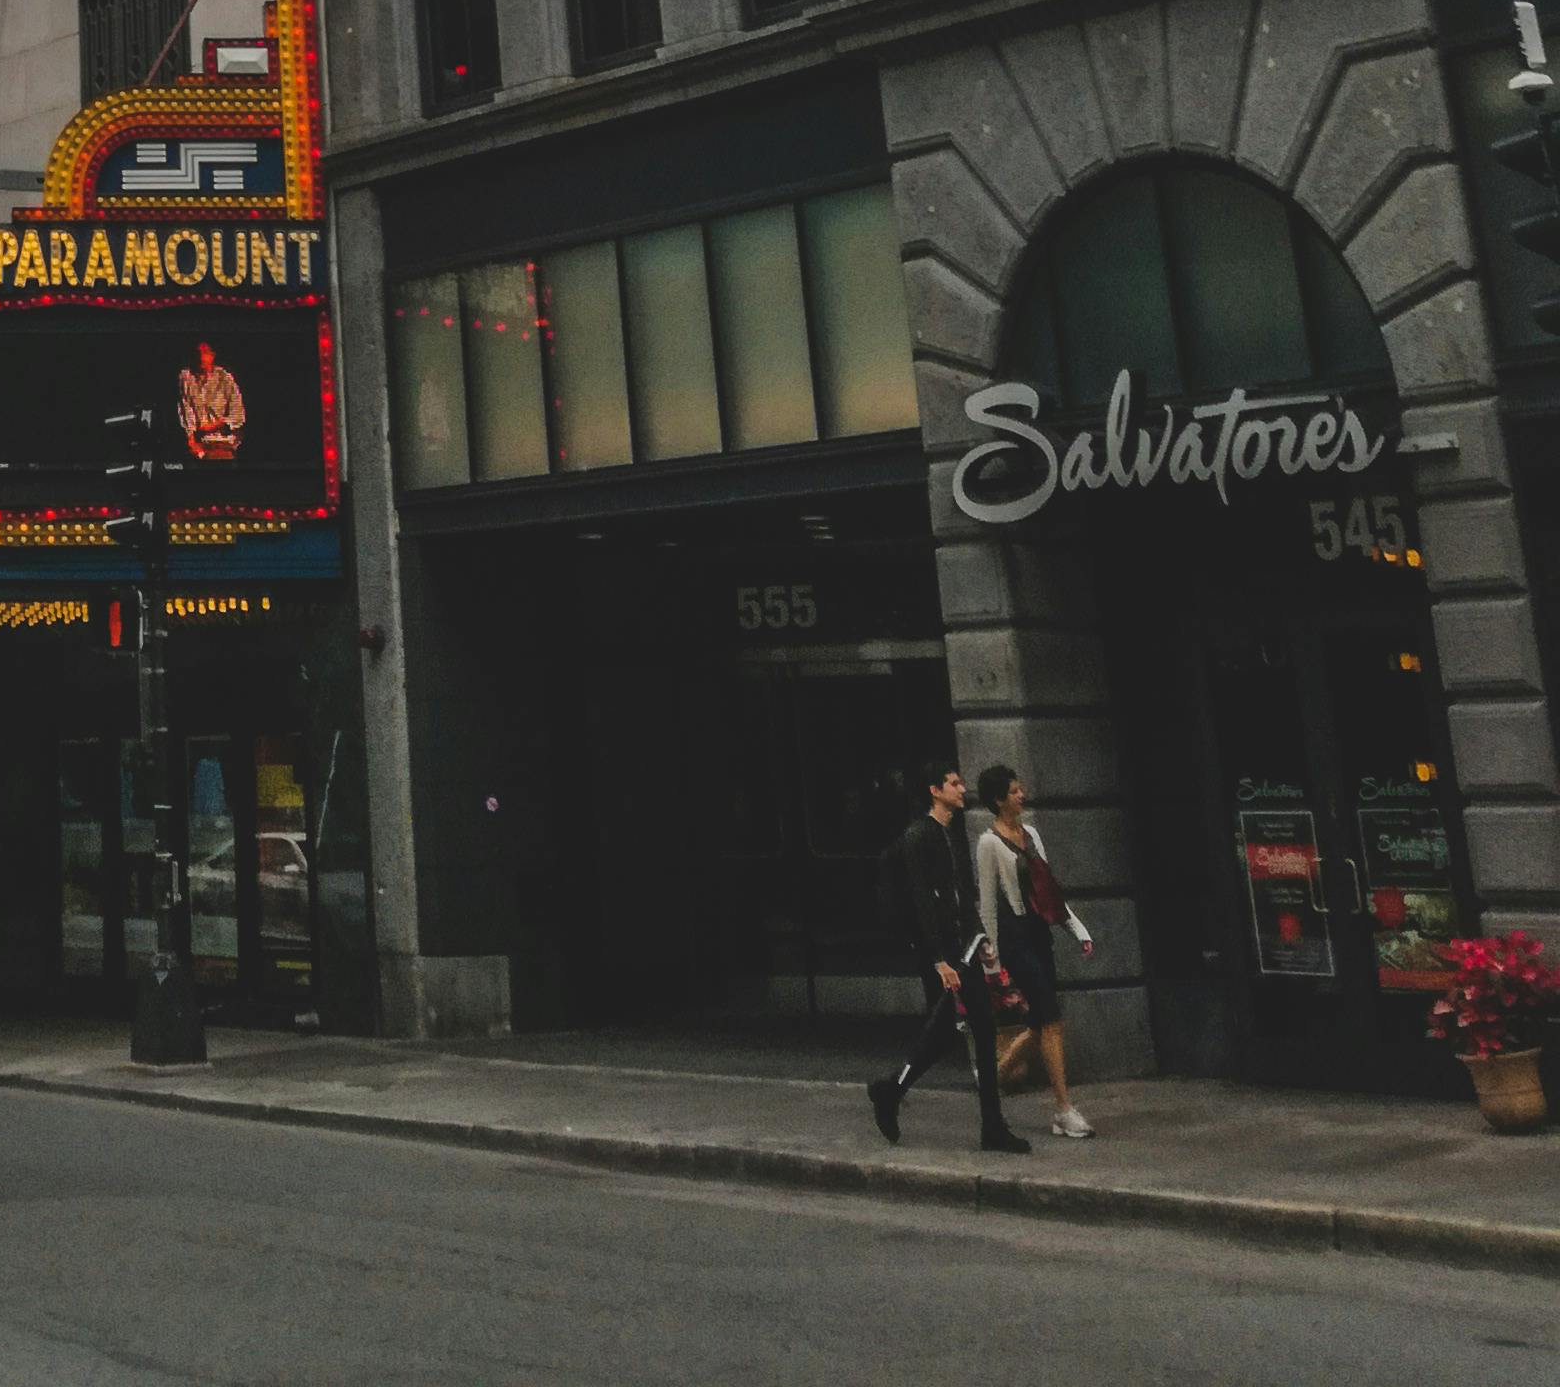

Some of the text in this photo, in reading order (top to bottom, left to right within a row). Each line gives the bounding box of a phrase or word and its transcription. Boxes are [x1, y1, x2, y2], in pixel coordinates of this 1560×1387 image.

[953, 368, 1386, 524] Salvatore's
[1309, 494, 1408, 561] 545
[734, 584, 818, 630] 555
